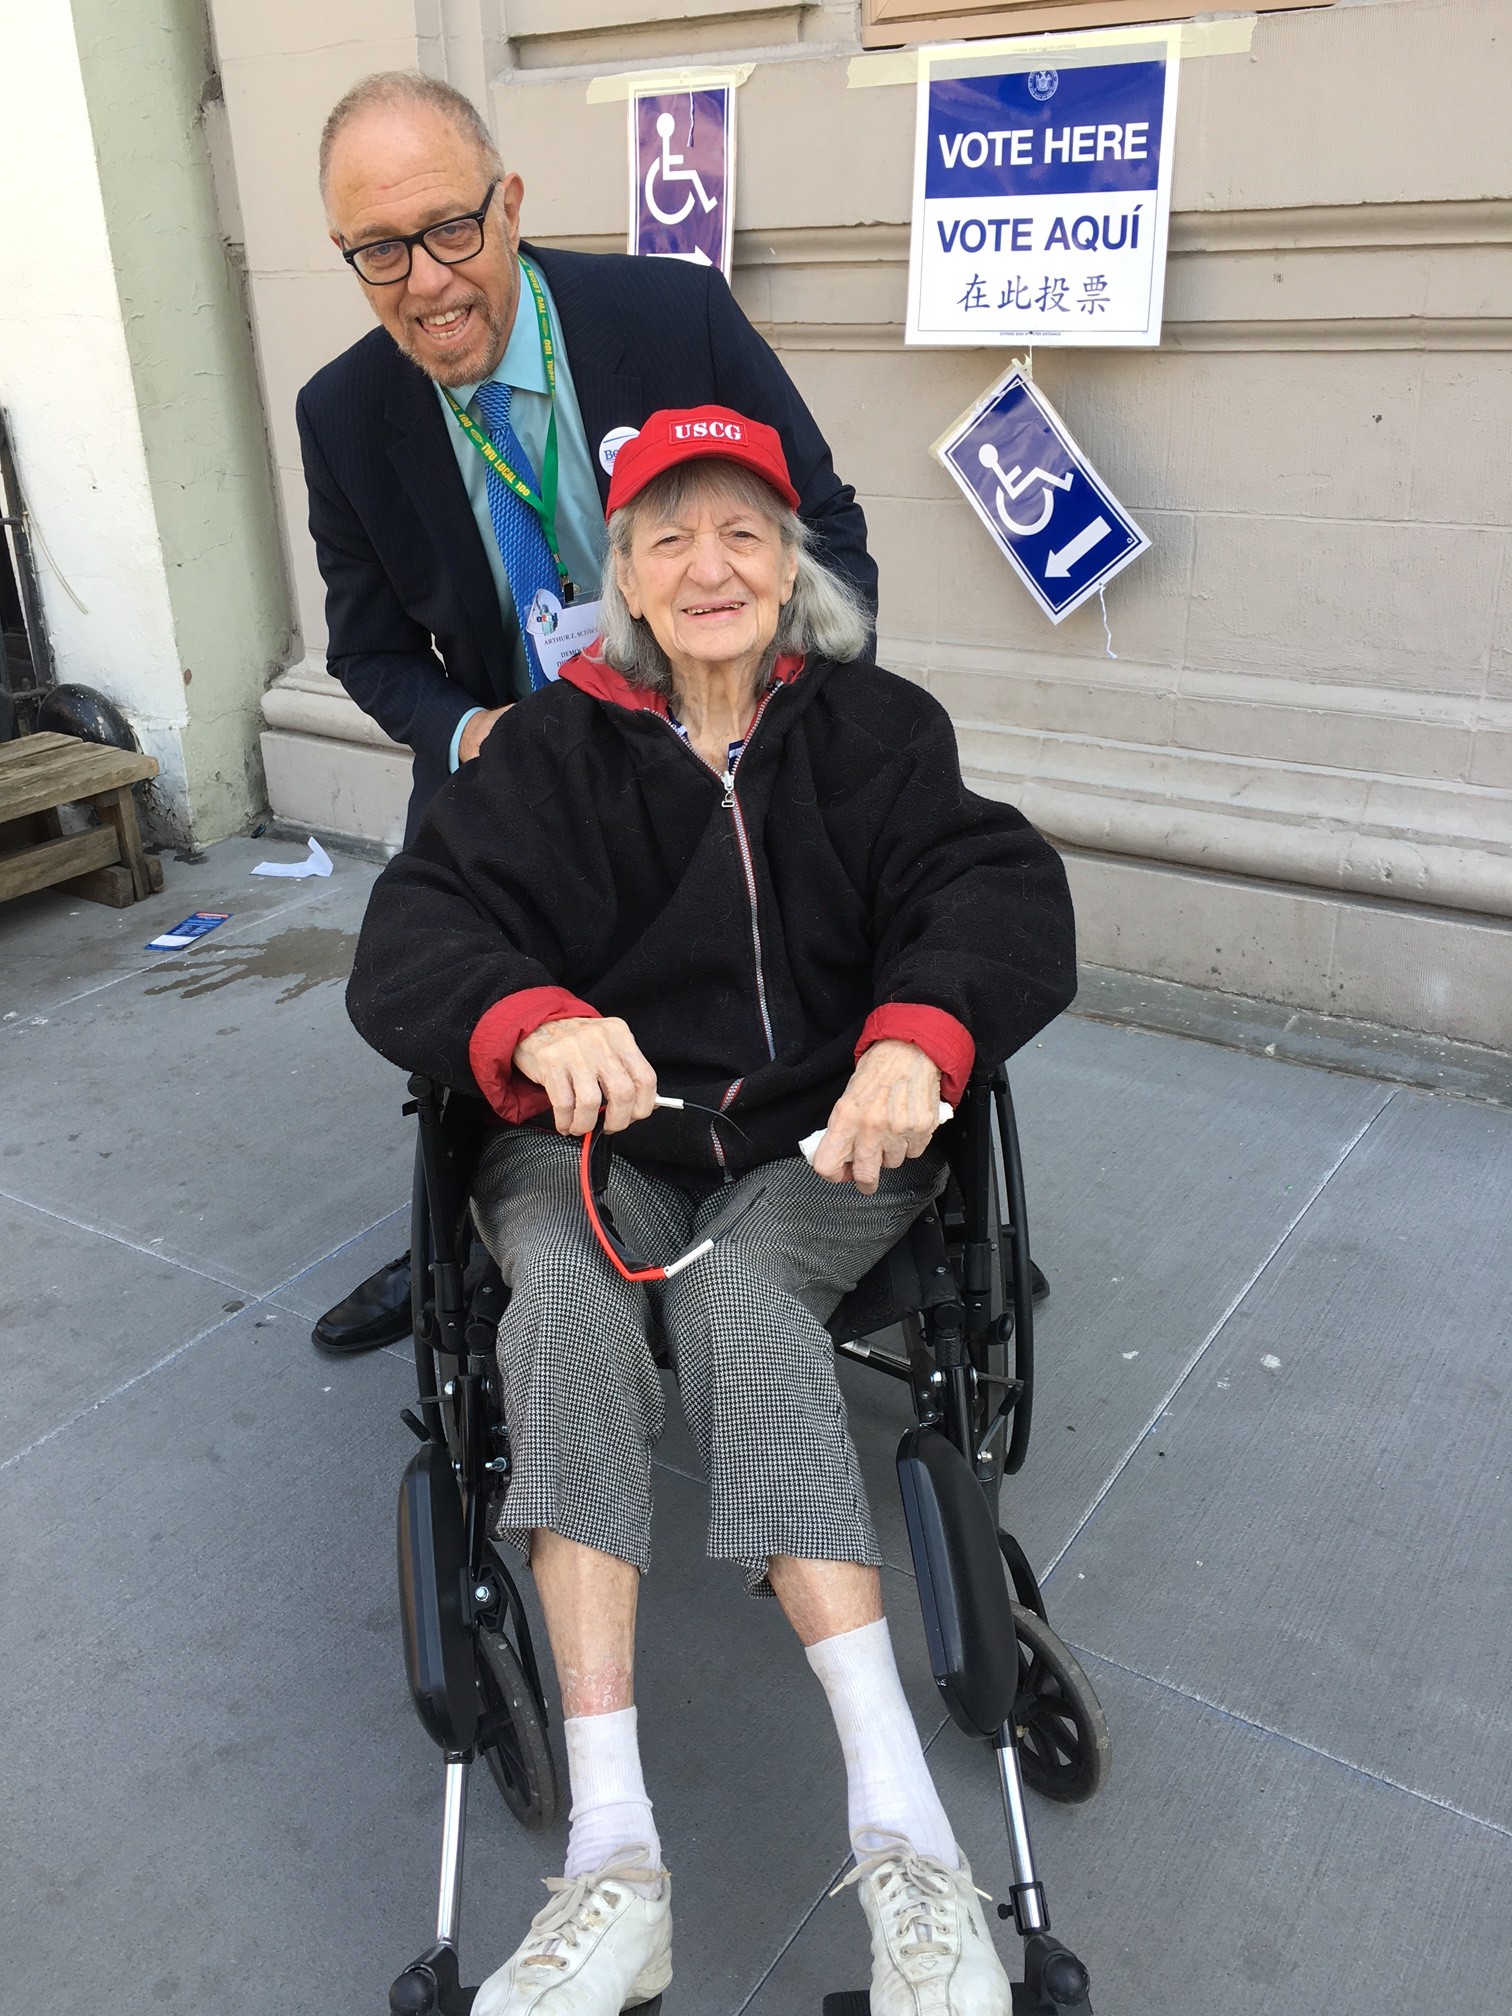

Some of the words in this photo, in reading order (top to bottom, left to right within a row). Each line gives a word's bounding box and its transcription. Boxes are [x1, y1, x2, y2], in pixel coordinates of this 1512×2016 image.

[938, 129, 1033, 168] VOTE
[1044, 122, 1149, 164] HERE
[937, 218, 1034, 253] VOTE
[1044, 204, 1144, 252] AQUÍ
[536, 296, 547, 313] TWU
[956, 273, 1111, 315] 在此投票
[543, 339, 553, 355] 100
[674, 421, 742, 441] USCG
[458, 413, 472, 428] 100
[481, 442, 498, 461] TWU
[494, 459, 517, 484] LOCAL
[515, 481, 531, 496] 100
[544, 634, 570, 645] ARTHUR
